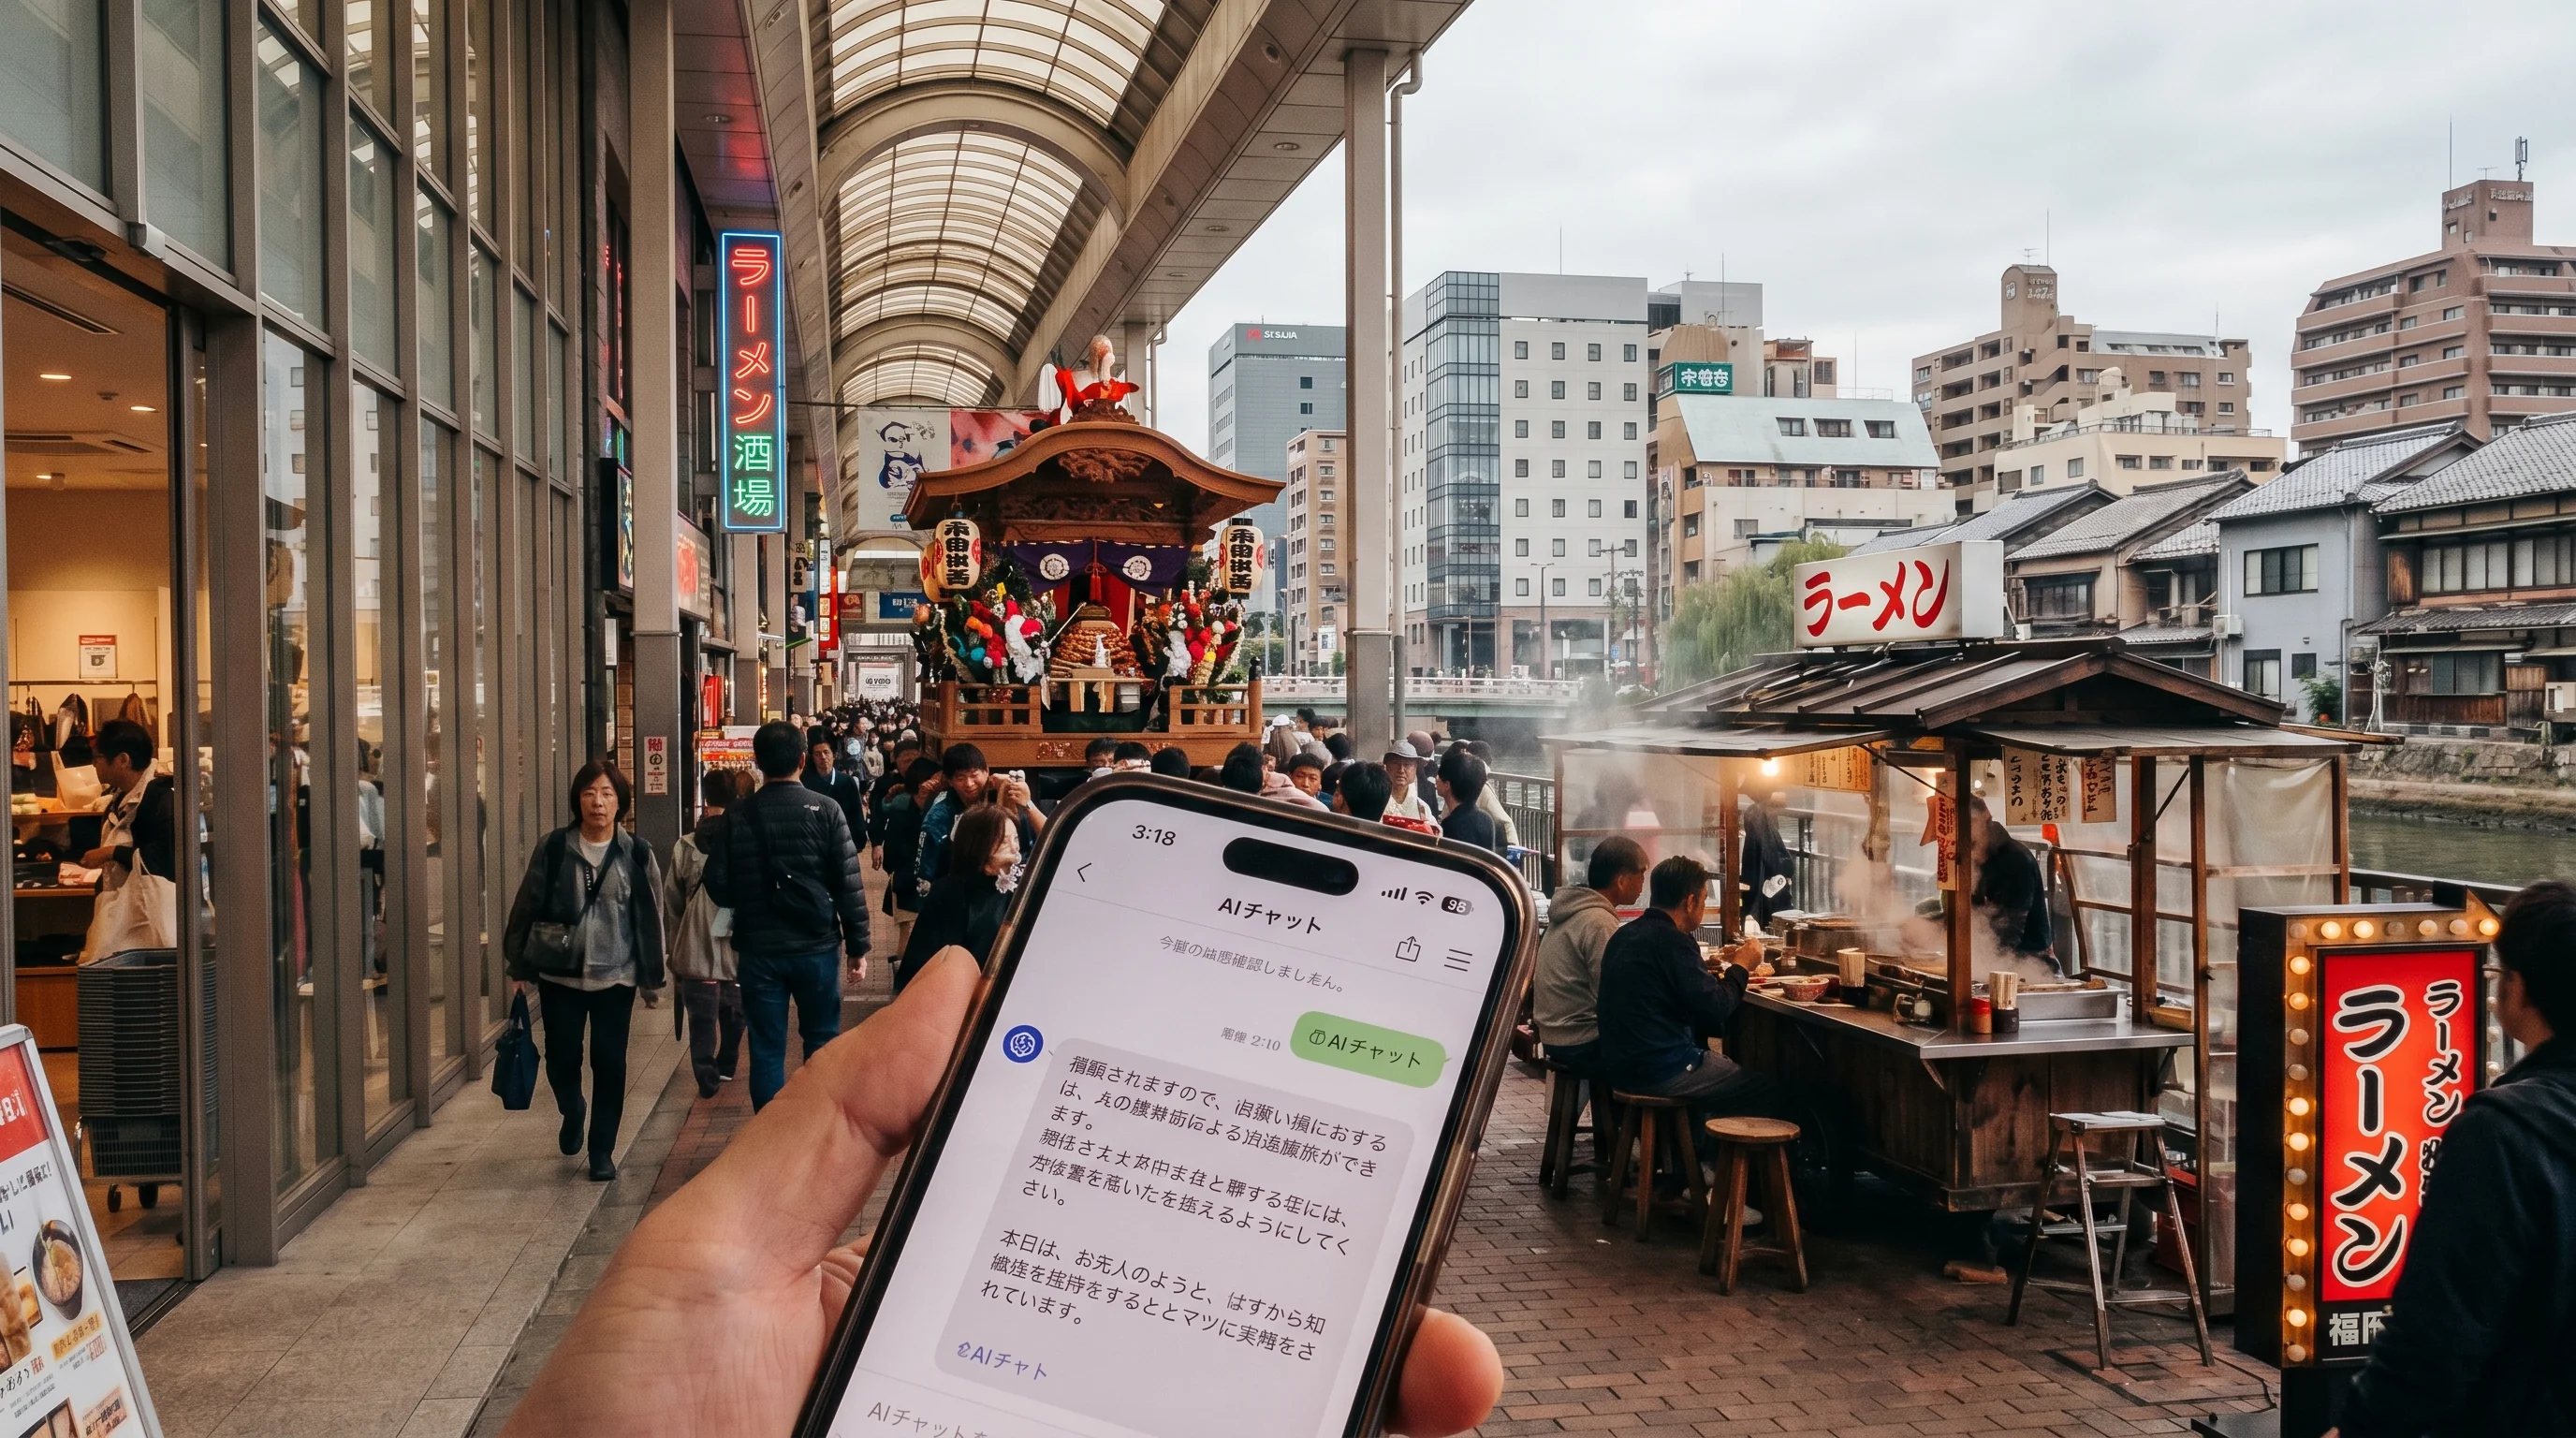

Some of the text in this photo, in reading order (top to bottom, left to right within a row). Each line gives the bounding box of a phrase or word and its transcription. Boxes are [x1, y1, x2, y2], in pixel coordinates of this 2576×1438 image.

[731, 246, 774, 518] ラーメン酒場
[1804, 559, 1950, 637] ラーメン
[1132, 824, 1177, 846] 3:18
[1217, 897, 1322, 934] AIチャット
[1250, 1034, 1281, 1051] 2:10
[1327, 1034, 1421, 1068] AIチャット
[2422, 979, 2463, 1127] ラーメン
[1050, 1105, 1092, 1131] ます。
[2333, 985, 2410, 1288] ラーメン
[1022, 1179, 1065, 1206] さい。
[980, 1280, 1081, 1325] れています。
